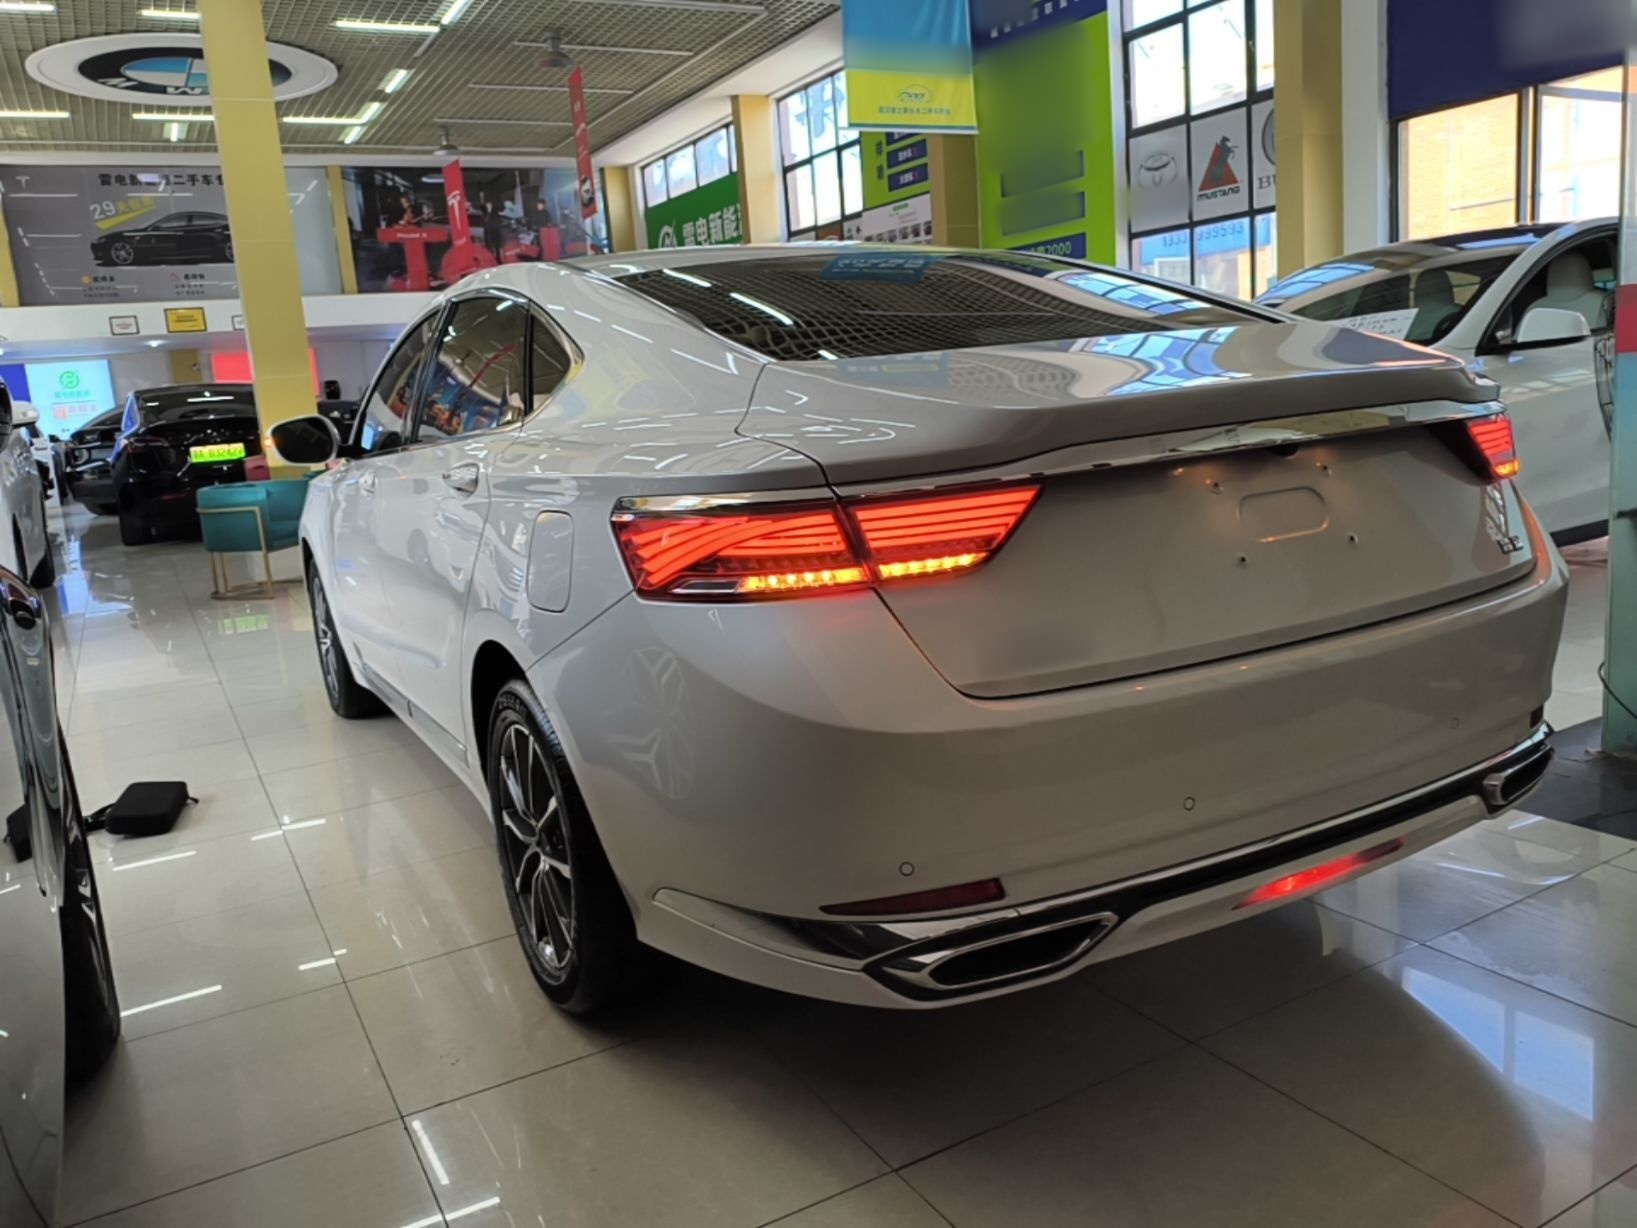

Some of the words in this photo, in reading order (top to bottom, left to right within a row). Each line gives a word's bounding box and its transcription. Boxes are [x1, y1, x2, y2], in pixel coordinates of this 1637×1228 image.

[1196, 185, 1241, 201] MUSTANG
[682, 203, 743, 248] 雷电新能
